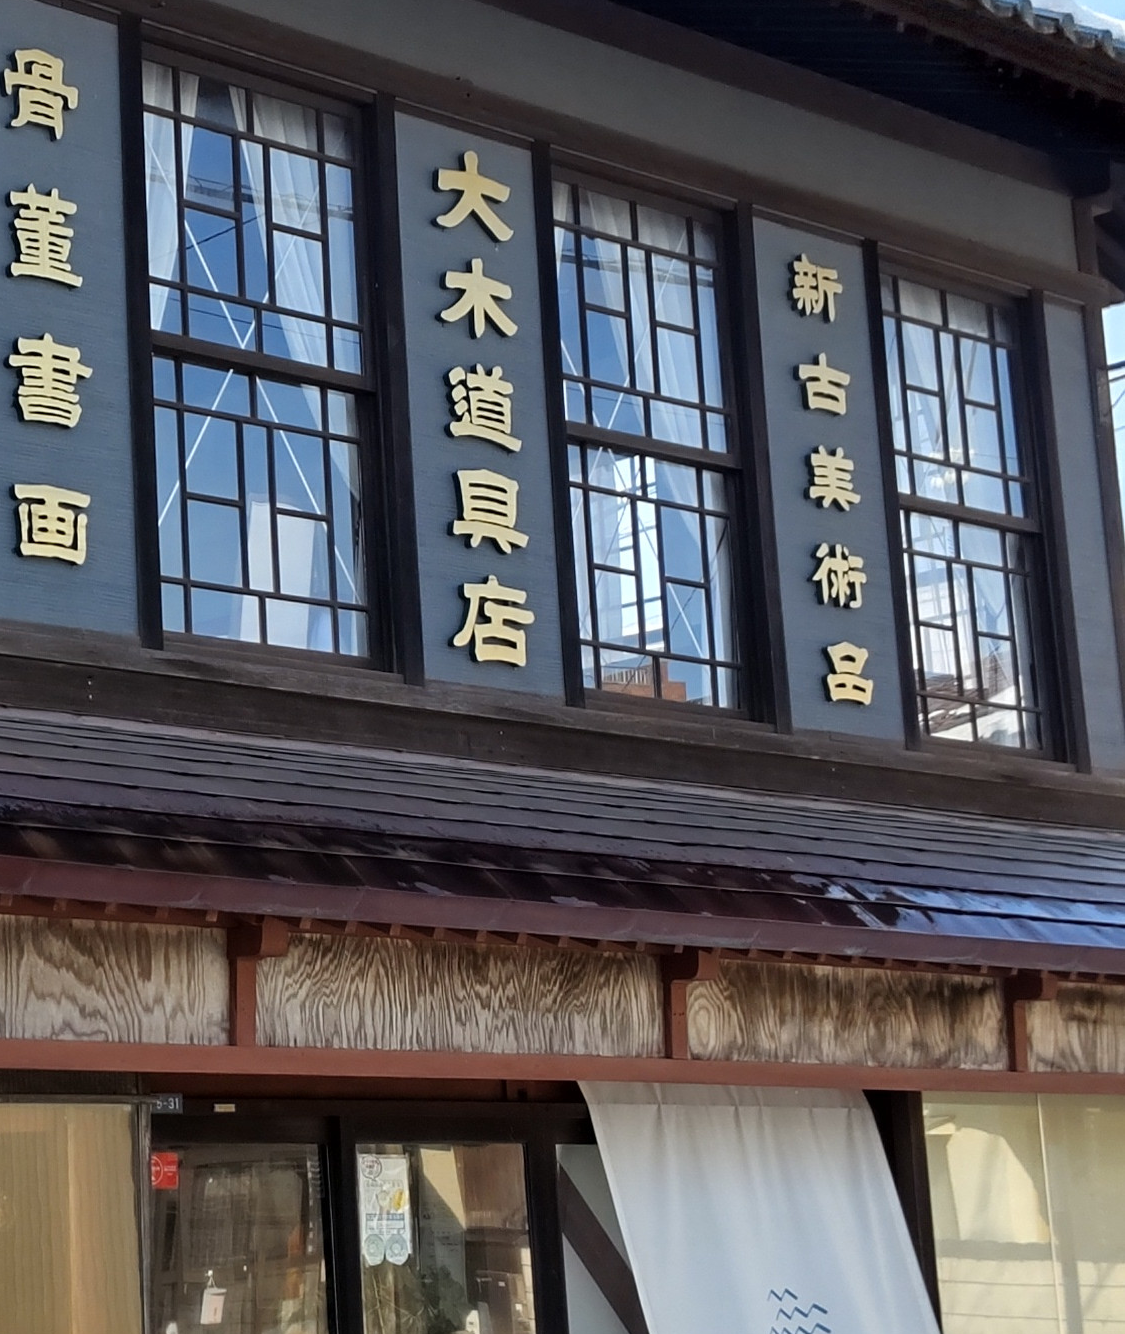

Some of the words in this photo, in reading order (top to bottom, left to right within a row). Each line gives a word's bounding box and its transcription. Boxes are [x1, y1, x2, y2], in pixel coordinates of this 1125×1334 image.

[3, 47, 93, 566] 骨董書画
[431, 149, 536, 668] 大木道具店
[788, 253, 875, 707] 新古美術品
